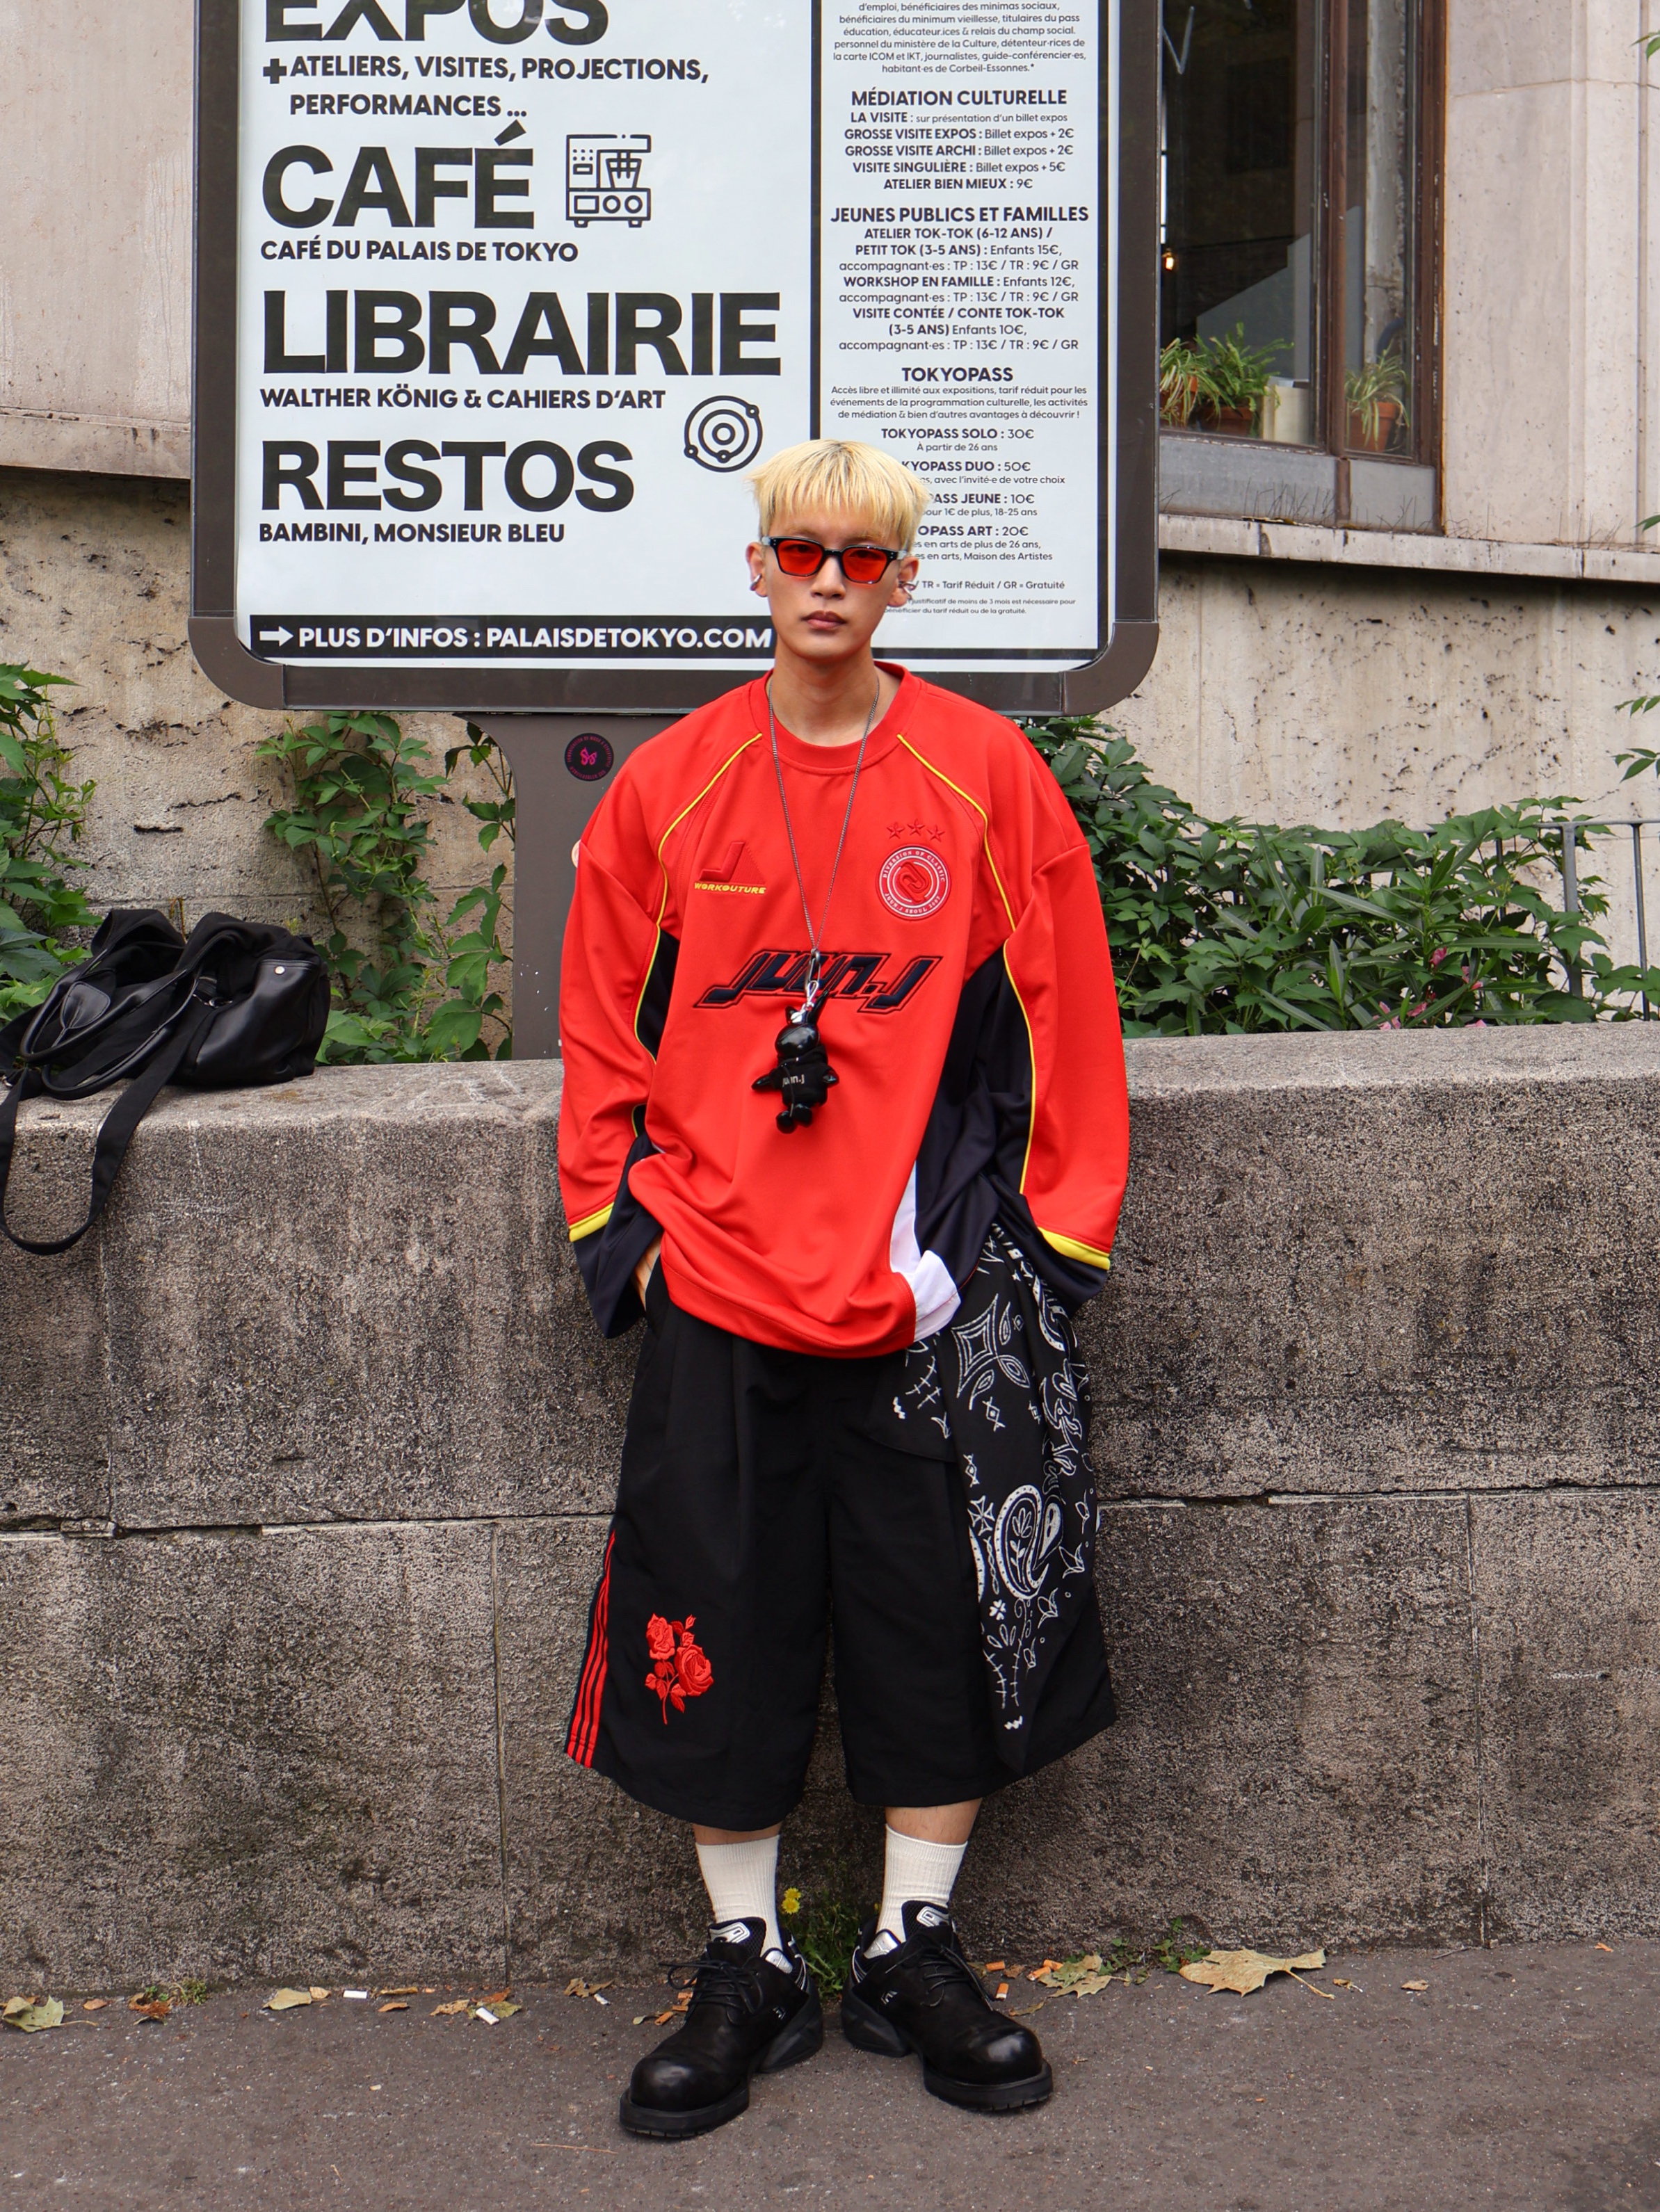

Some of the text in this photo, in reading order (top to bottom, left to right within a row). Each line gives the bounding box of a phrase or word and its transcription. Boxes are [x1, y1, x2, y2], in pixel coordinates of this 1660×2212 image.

[908, 52, 922, 60] IKT,
[924, 53, 979, 62] journalistes,
[290, 56, 708, 83] ATELIERS, VISITES, PROJECTIONS,
[852, 87, 1067, 106] MÉDIATION CULTURELLE
[291, 94, 501, 116] PERFORMANCES
[851, 112, 867, 122] LA
[870, 112, 908, 122] VISITE
[933, 115, 991, 124] présentation
[844, 128, 1074, 140] GROSSE VISITE EXPOS Billet expos 2€
[845, 145, 1073, 157] GROSSE VISITE ARCHI Billet expos 2€
[853, 159, 1065, 174] VISITE SINGULIÈRE Billet expos 5€
[262, 120, 534, 229] CAFÉ
[884, 179, 1033, 189] ATELIER BIEN MIEUX 9€
[830, 207, 1088, 222] JEUNES PUBLICS ET FAMILLES
[864, 227, 1042, 240] ATELIER TOK-TOK (6-12 ANS)
[261, 235, 578, 261] CAFÉ DU PALAIS DE TOKYO
[856, 244, 1061, 257] PETIT TOK (3-5 ANS) Enfants 15€,
[953, 261, 967, 270] TP
[976, 261, 997, 270] 13€
[1010, 260, 1023, 270] TR
[1033, 260, 1049, 270] 9€
[1061, 260, 1078, 270] GR
[844, 276, 1074, 287] WORKSHOP EN FAMILLE Enfants 12€,
[853, 305, 1064, 318] VISITE CONTÉE CONTE TOK-TOK
[264, 290, 781, 376] LIBRAIRIE
[889, 324, 1026, 336] (3-5 ANS) Enfants 10€,
[902, 367, 1013, 382] TOKYOPASS
[260, 388, 371, 407] WALTHER
[378, 383, 458, 408] KÖNIG
[464, 389, 481, 408] &
[487, 389, 590, 408] CAHIERS
[942, 387, 996, 395] expositions,
[881, 428, 1033, 439] TOKYOPASS SOLO 30€
[965, 461, 1030, 471] DUO 50€
[261, 439, 634, 512] RESTOS
[961, 494, 1034, 503] JEUNE 10€
[259, 523, 564, 544] BAMBINI, MONSIEUR BLEU
[967, 526, 1028, 535] ART 20€
[300, 627, 772, 647] PLUS D'INFOS PALAISDETOKYO.COM
[694, 882, 766, 894] WORKOUTURE
